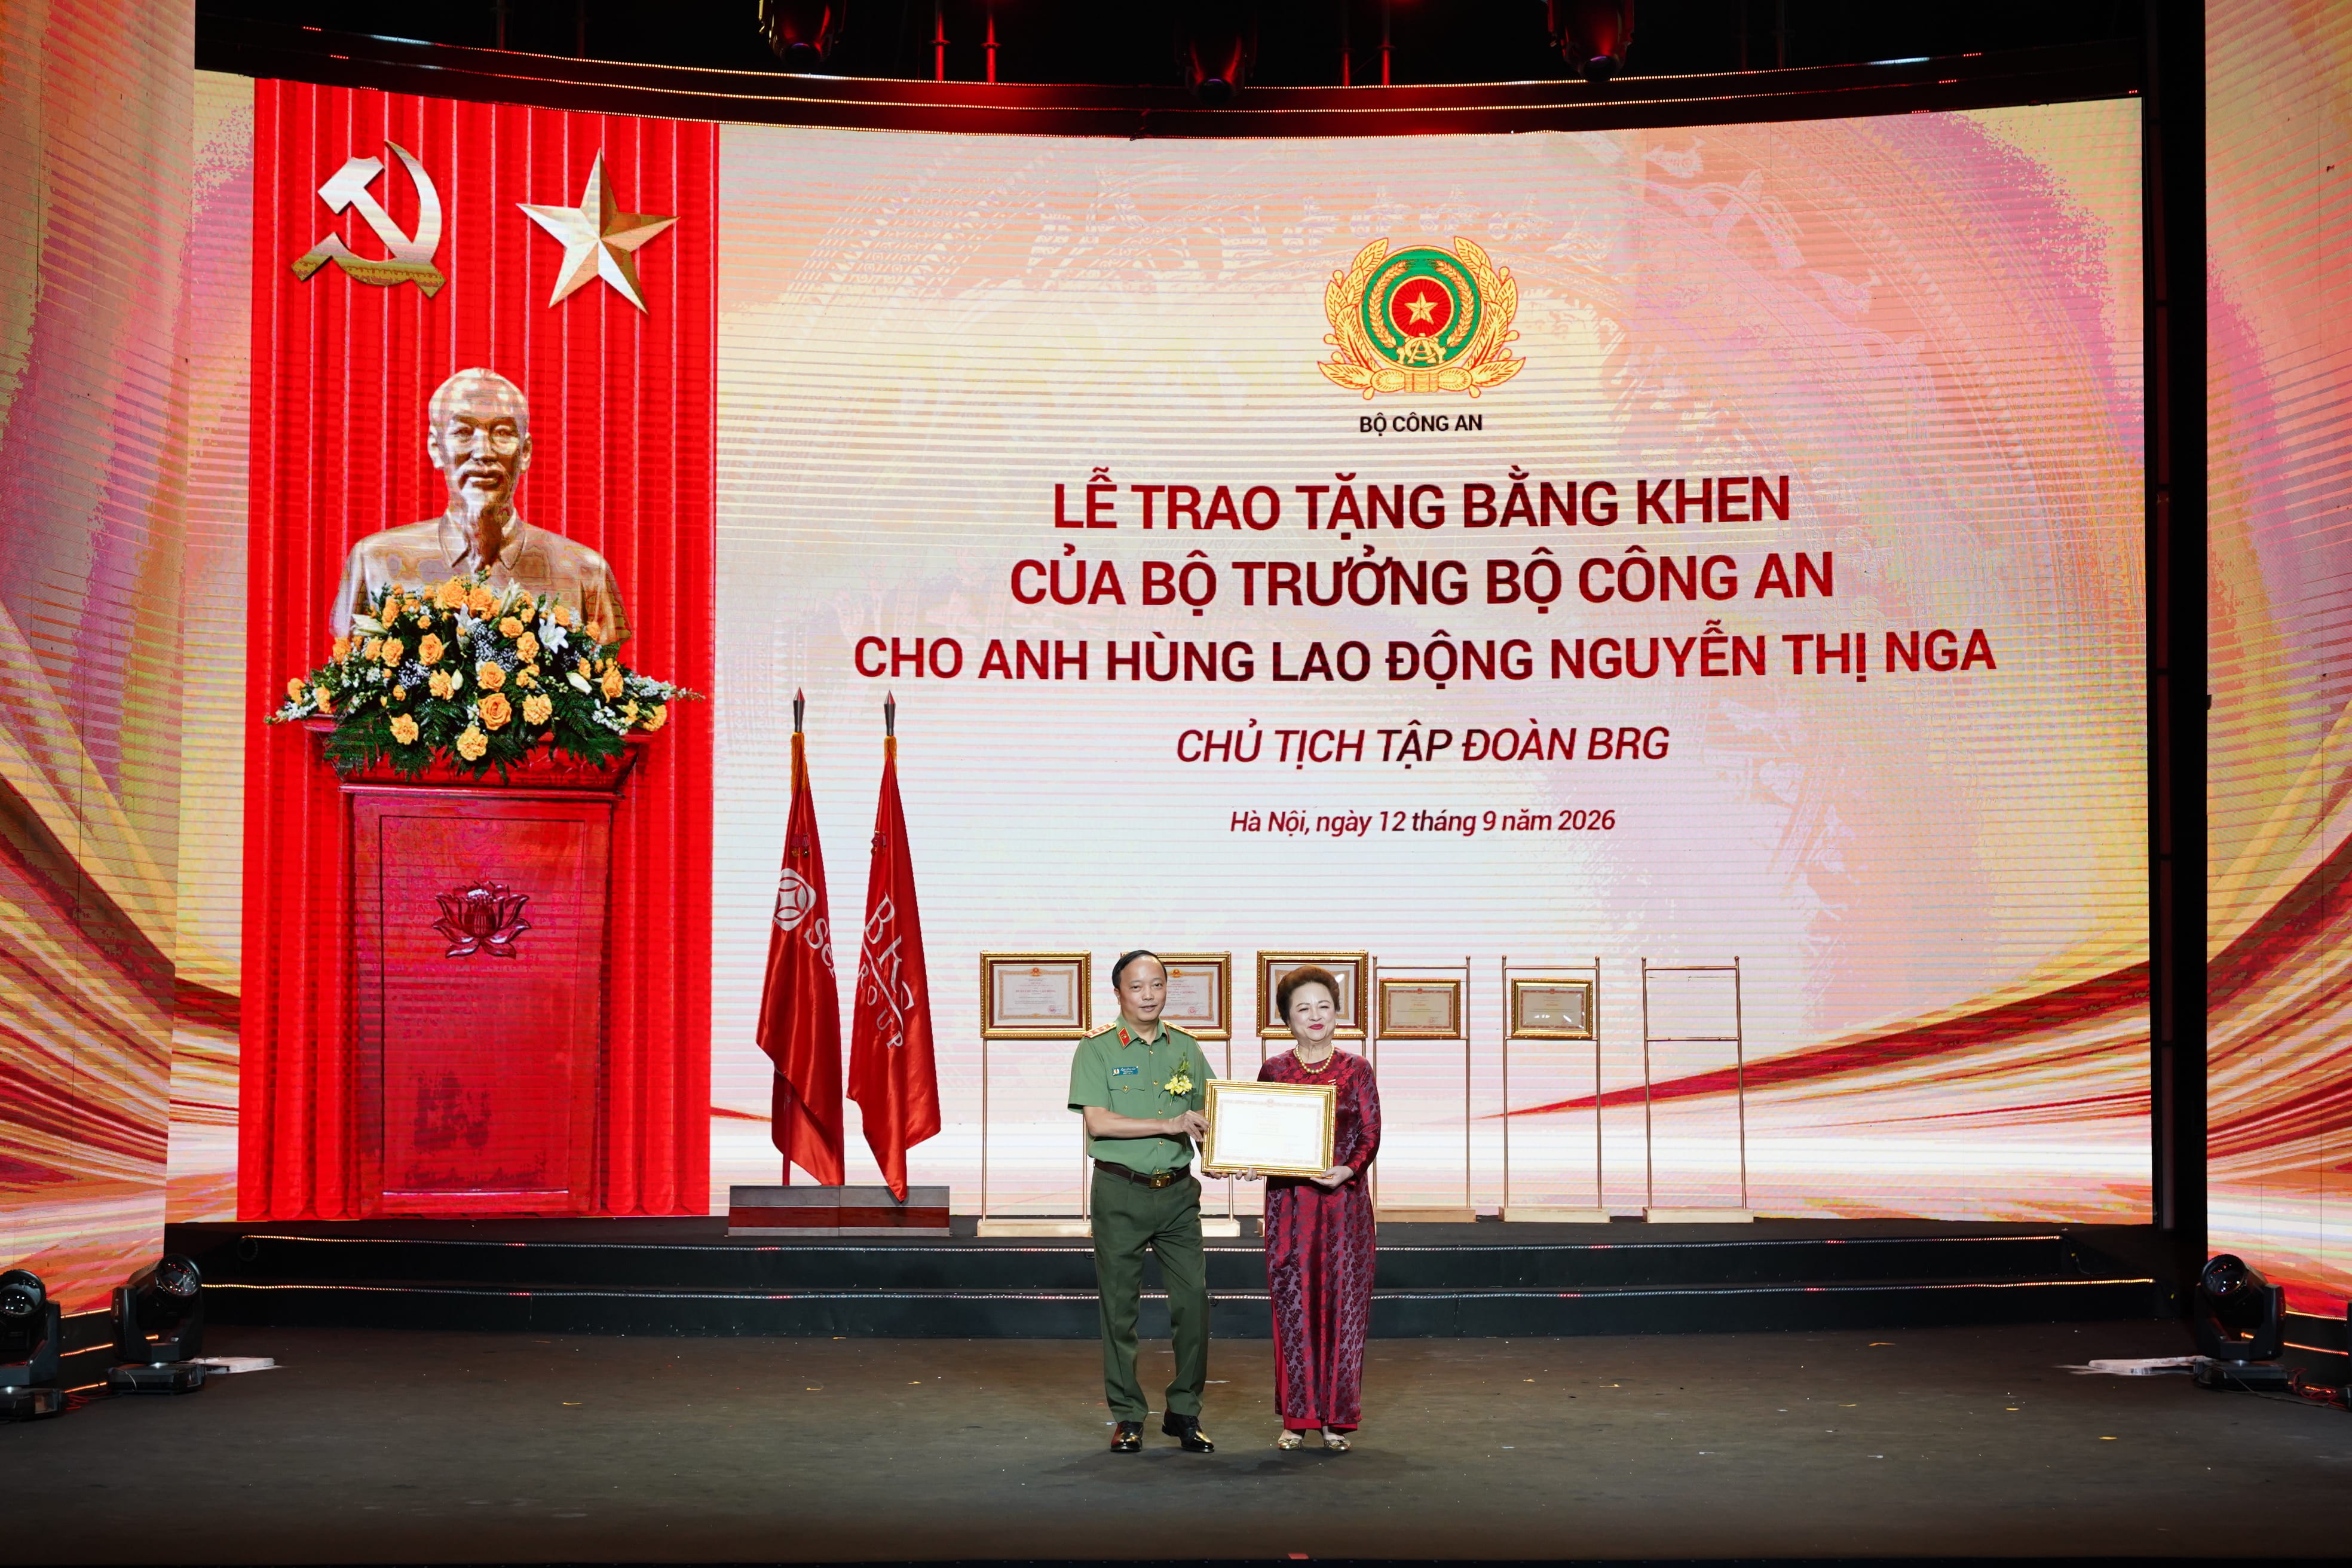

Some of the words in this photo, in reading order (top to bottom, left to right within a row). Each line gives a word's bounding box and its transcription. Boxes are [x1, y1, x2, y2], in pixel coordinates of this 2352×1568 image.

[1360, 412, 1387, 436] BỘ
[1392, 412, 1448, 432] CÔNG
[1454, 415, 1483, 431] AN
[1055, 467, 1117, 529] LỄ
[1131, 485, 1281, 531] TRAO
[1295, 473, 1445, 540] TẶNG
[1463, 466, 1618, 528] BẰNG
[1637, 476, 1790, 525] KHEN
[1011, 543, 1126, 605] CỦA
[1142, 550, 1217, 616] BỘ
[1232, 544, 1468, 607] TRƯỞNG
[1487, 547, 1562, 614] BỘ
[1579, 545, 1738, 604] CÔNG
[1754, 552, 1833, 599] AN
[855, 636, 963, 679] CHO
[978, 639, 1088, 680] ANH
[1107, 631, 1254, 682] HÙNG
[1272, 641, 1371, 682] LAO
[1385, 629, 1533, 690] ĐỘNG
[1551, 619, 1766, 679] NGUYỄN
[1781, 633, 1867, 682] THỊ
[1885, 629, 1997, 673] NGA
[1177, 718, 1263, 762] CHỦ
[1275, 729, 1365, 770] TỊCH
[1377, 719, 1453, 769] TẬP
[1462, 718, 1577, 761] ĐOÀN
[1587, 727, 1670, 760] BRG
[1230, 810, 1261, 832] Hà
[1268, 810, 1310, 837] Nội,
[1316, 810, 1373, 837] ngày
[1380, 811, 1406, 831] 12
[1412, 810, 1477, 837] tháng
[1483, 810, 1497, 831] 9
[1502, 809, 1552, 831] năm
[1558, 809, 1616, 831] 2026
